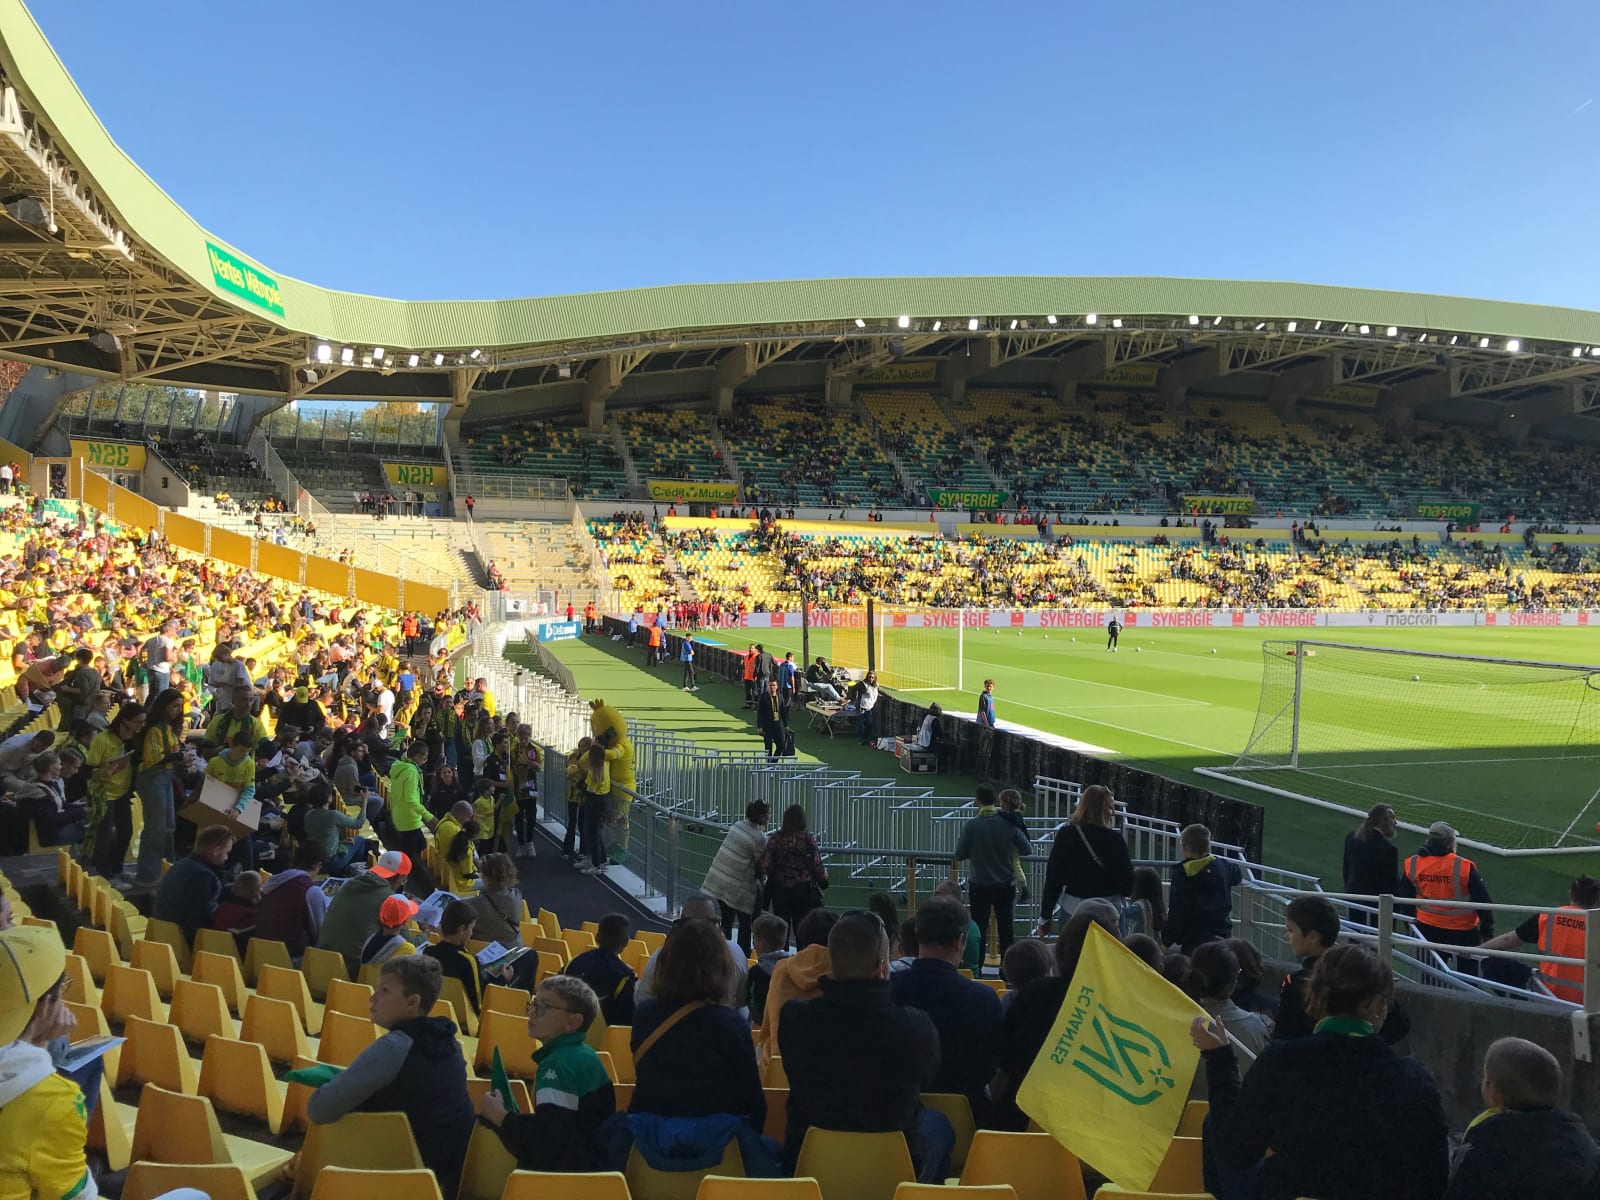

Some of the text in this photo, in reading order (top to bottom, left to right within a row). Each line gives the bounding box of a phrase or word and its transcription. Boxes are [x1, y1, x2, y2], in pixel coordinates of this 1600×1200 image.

[87, 442, 129, 466] N2G
[398, 465, 433, 484] N2H
[652, 486, 734, 500] Crédit Mutuel
[939, 492, 999, 508] SYNERGIE
[1199, 500, 1252, 512] NANTES
[923, 611, 990, 627] SYNERGIE
[1040, 611, 1104, 627] SYNERGIE
[1152, 611, 1213, 627] SYNERGIE
[1259, 611, 1317, 627] SYNERGIE
[1385, 614, 1437, 625] macron
[1509, 611, 1562, 626] SYNERGIE
